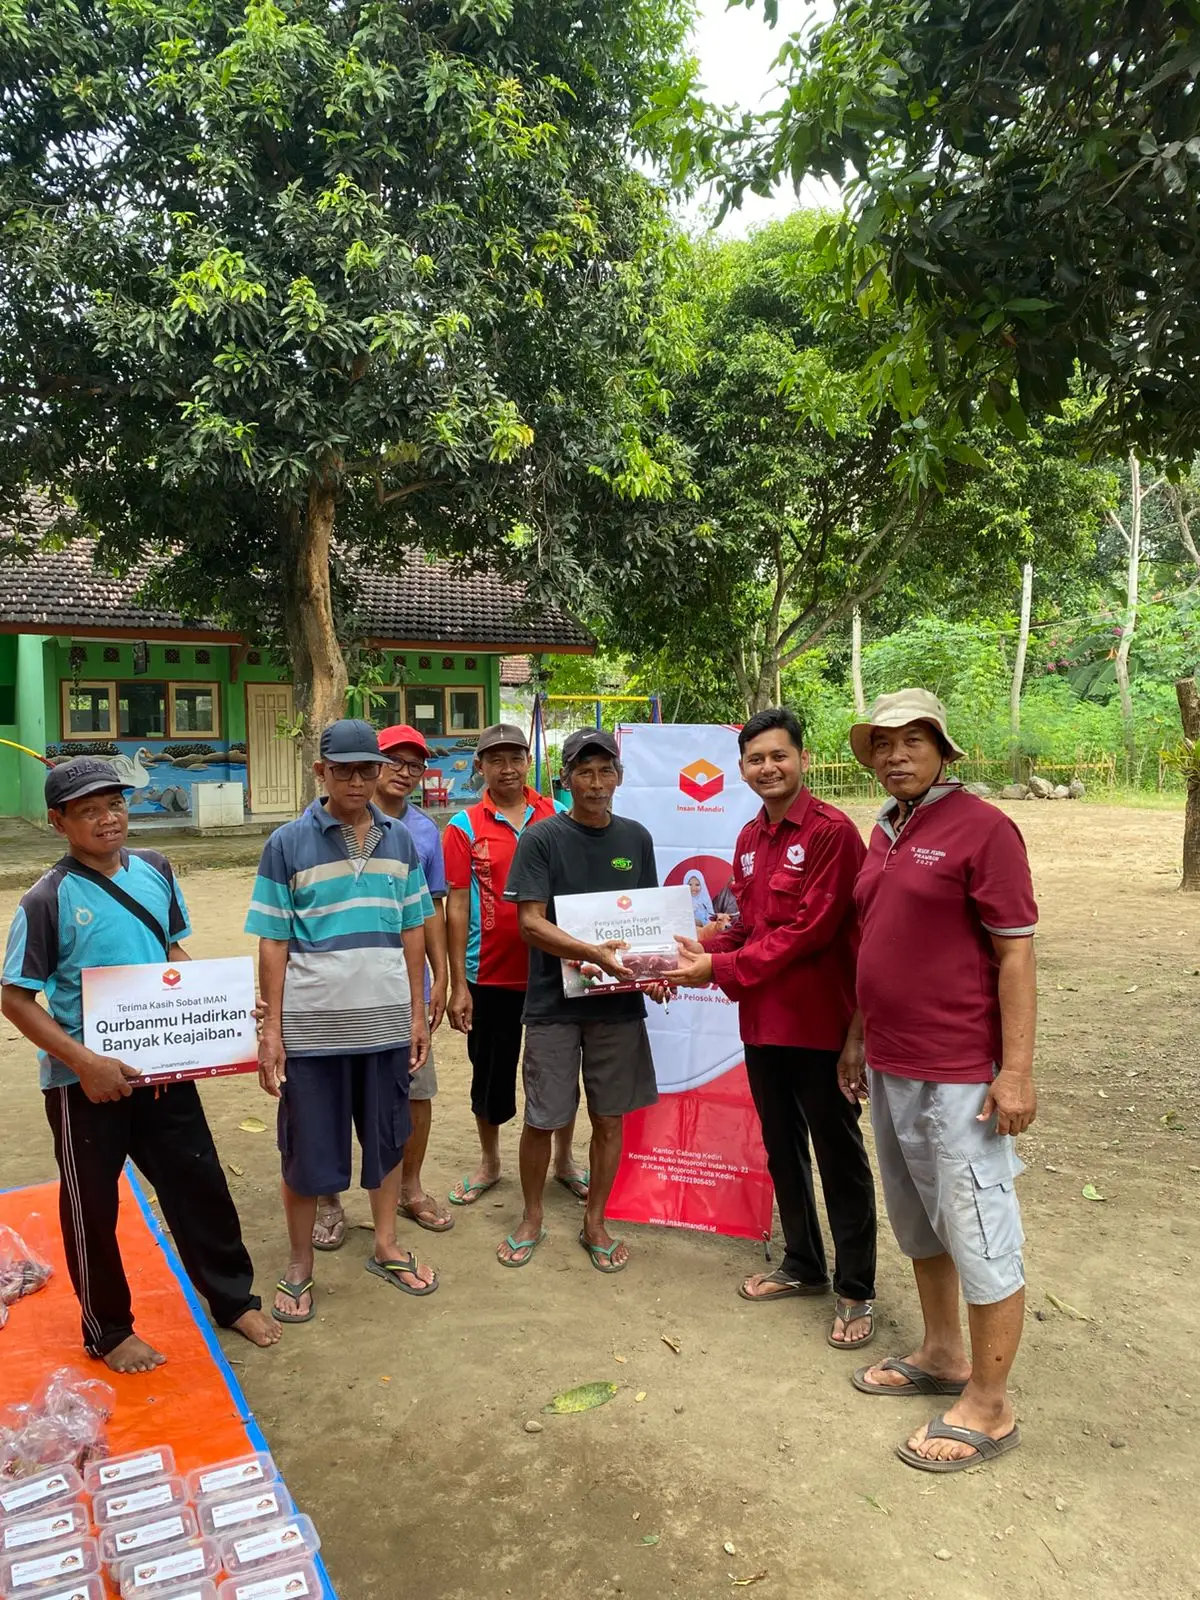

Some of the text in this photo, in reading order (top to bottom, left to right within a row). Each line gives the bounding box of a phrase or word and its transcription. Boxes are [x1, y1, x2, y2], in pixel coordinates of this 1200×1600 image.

[594, 915, 660, 927] Penyaluran Program
[595, 924, 662, 941] Keajaiban
[117, 995, 227, 1013] Terima Kasih Sobat IMAN
[684, 994, 713, 1002] Pelosok
[95, 1008, 247, 1035] Qurbanmu Hadirkan
[102, 1026, 243, 1052] Banyak Keajaiban.
[628, 1152, 658, 1162] Komplek
[658, 1156, 676, 1164] Ruko
[677, 1158, 707, 1168] Mojoroto
[708, 1162, 726, 1171] Indah
[652, 1146, 722, 1161] Kantor Cabang Kediri
[715, 1171, 736, 1181] Kediri
[649, 1217, 717, 1233] www.insanmandiri.id
